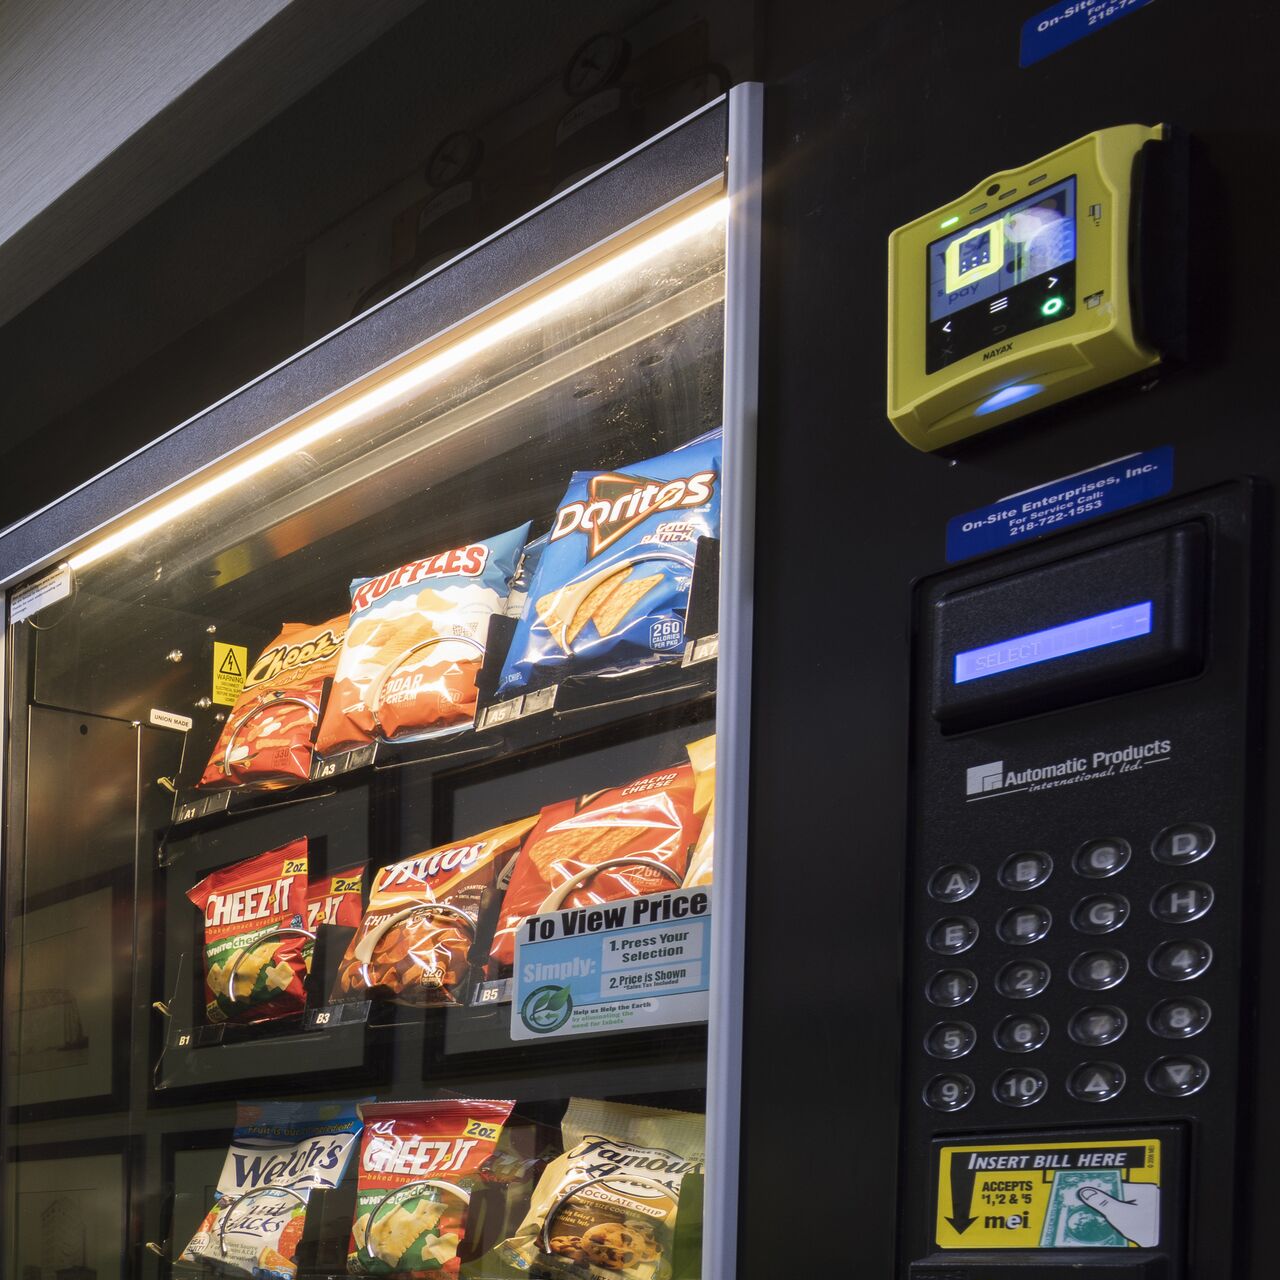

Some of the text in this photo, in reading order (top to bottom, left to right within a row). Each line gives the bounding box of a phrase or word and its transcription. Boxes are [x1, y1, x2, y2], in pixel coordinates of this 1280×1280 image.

[983, 343, 1014, 362] NAYAX
[550, 472, 716, 542] Doritos
[962, 463, 1159, 532] On-Site Enterprises, Inc.
[1009, 491, 1104, 527] For Service Call:
[1009, 500, 1103, 536] 218-722-1553
[350, 545, 487, 614] RUFFLES
[654, 621, 680, 636] 260
[653, 634, 680, 644] CALORIES
[975, 642, 1041, 671] SELECT
[217, 673, 244, 684] WARNING
[154, 714, 189, 727] UNION MADE
[490, 708, 506, 723] A5
[322, 763, 336, 776] A3
[1004, 739, 1171, 787] Automatic Products
[621, 780, 674, 796] CHEESE
[184, 807, 196, 820] A1
[945, 875, 965, 894] A
[1172, 834, 1197, 856] D
[526, 892, 708, 942] To View Price
[945, 925, 964, 946] E
[1089, 903, 1114, 924] G
[1171, 890, 1195, 912] H
[609, 931, 689, 952] 1. Press Your
[622, 946, 684, 963] Selection
[523, 957, 596, 984] Simply:
[609, 968, 686, 989] 2. Price is Shown
[949, 978, 960, 997] 1
[1017, 970, 1032, 989] 2
[1171, 949, 1191, 968] 4
[483, 988, 498, 1001] B5
[632, 1001, 651, 1009] Earth
[316, 1012, 330, 1024] B3
[944, 1031, 960, 1048] 5
[1015, 1023, 1031, 1042] 6
[1171, 1008, 1191, 1028] 8
[179, 1035, 190, 1046] B1
[942, 1077, 1037, 1102] 9 10
[232, 1140, 344, 1188] Welch's
[568, 1135, 704, 1174] Famous
[968, 1152, 1128, 1169] INSERT BILL HERE
[982, 1180, 1033, 1192] ACCEPTS
[1009, 1194, 1032, 1204] & $5
[635, 1204, 663, 1217] CHIP
[984, 1210, 1031, 1229] mei
